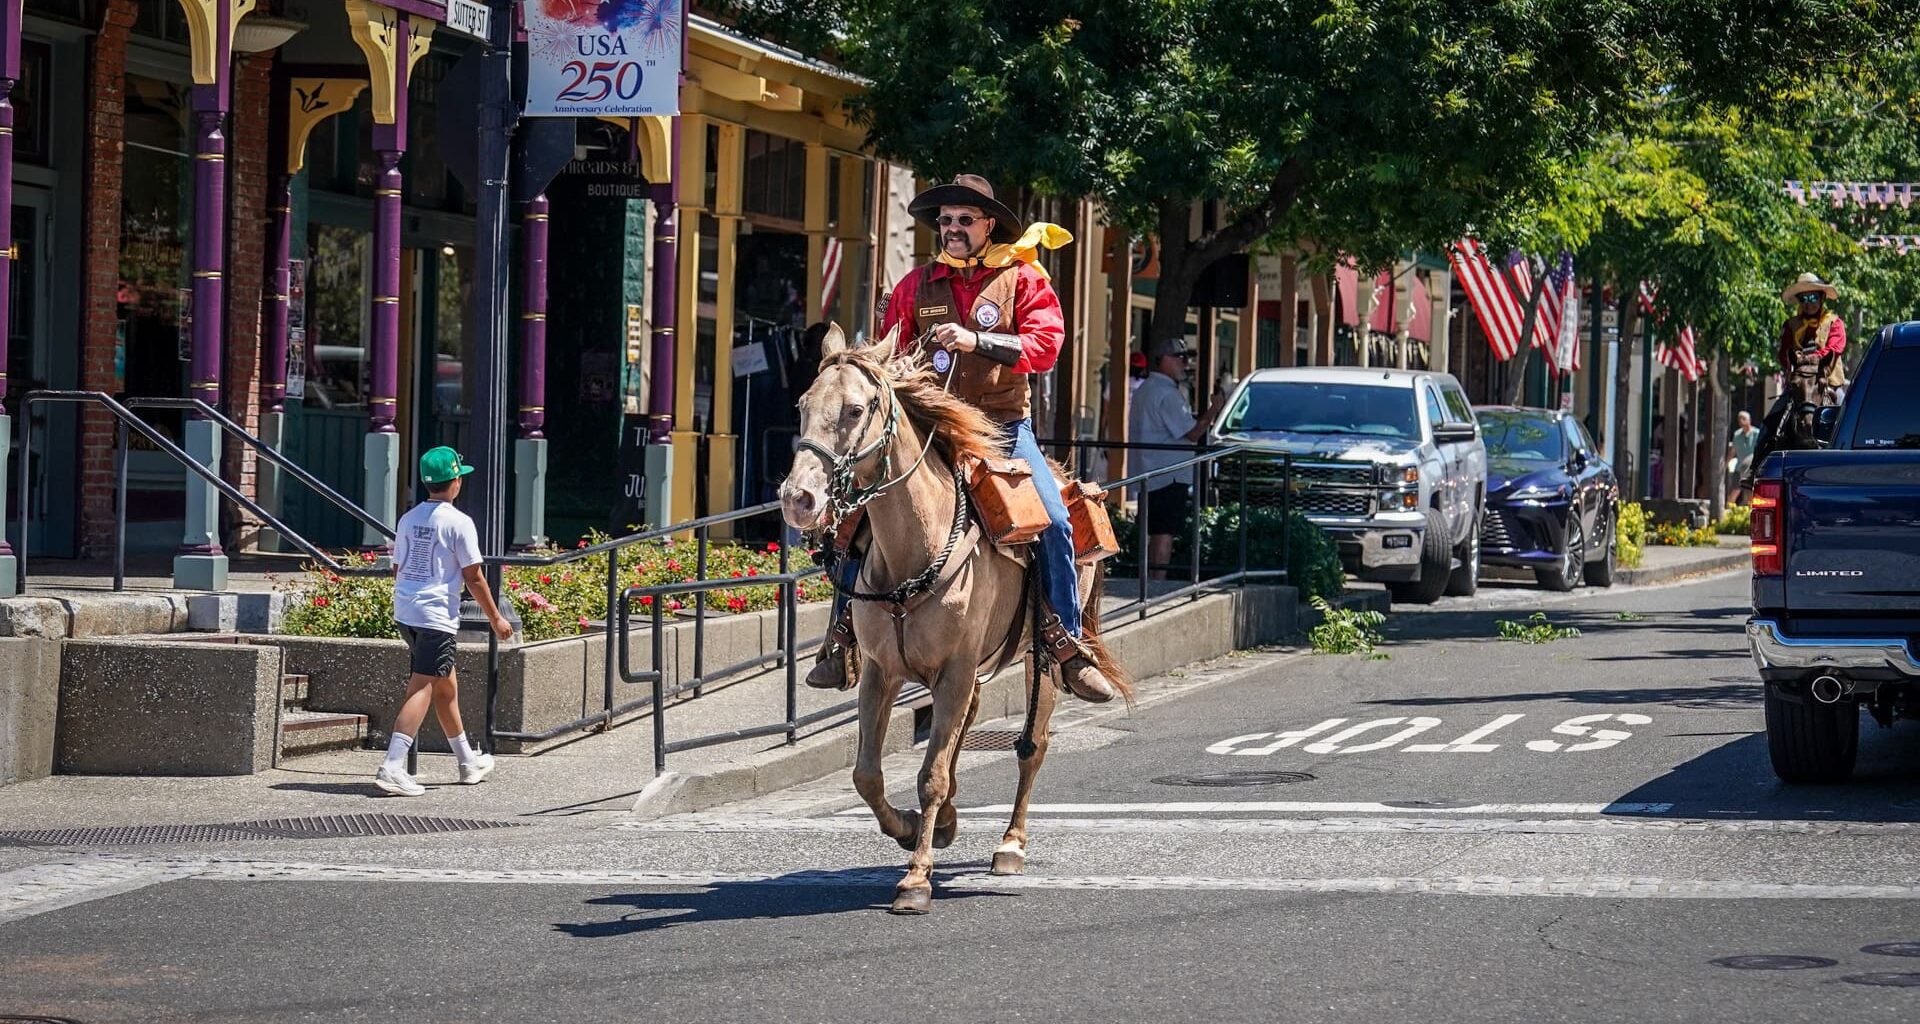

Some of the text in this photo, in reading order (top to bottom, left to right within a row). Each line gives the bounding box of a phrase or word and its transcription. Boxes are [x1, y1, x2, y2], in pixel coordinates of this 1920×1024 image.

[454, 1, 486, 34] SUTTER ST
[576, 34, 628, 56] USA
[556, 60, 643, 102] 250
[552, 105, 652, 115] Anniversary Celebration
[588, 184, 641, 196] BOUTIQUE
[1205, 713, 1653, 756] STOP
